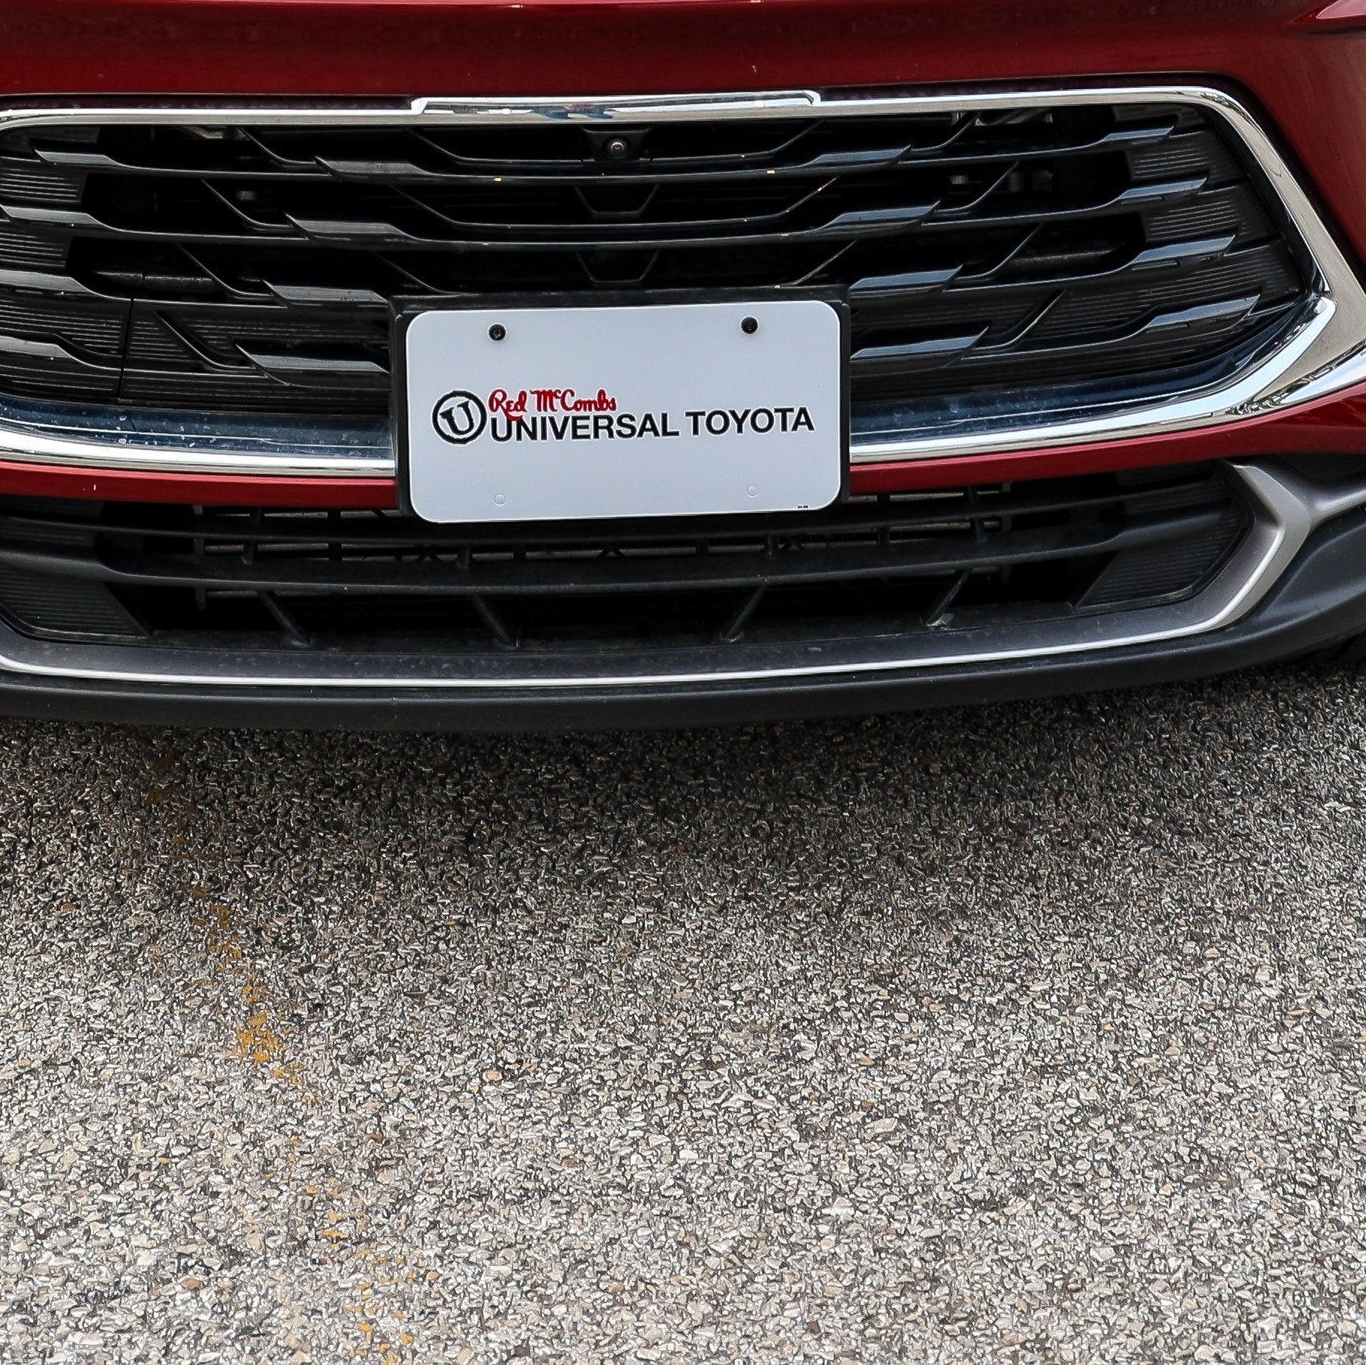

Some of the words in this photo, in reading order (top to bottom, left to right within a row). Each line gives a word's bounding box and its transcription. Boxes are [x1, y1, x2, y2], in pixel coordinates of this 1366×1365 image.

[488, 389, 528, 422] Red
[530, 388, 617, 412] McCombs
[490, 411, 680, 442] UNIVERSAL
[685, 407, 815, 436] TOYOTA
